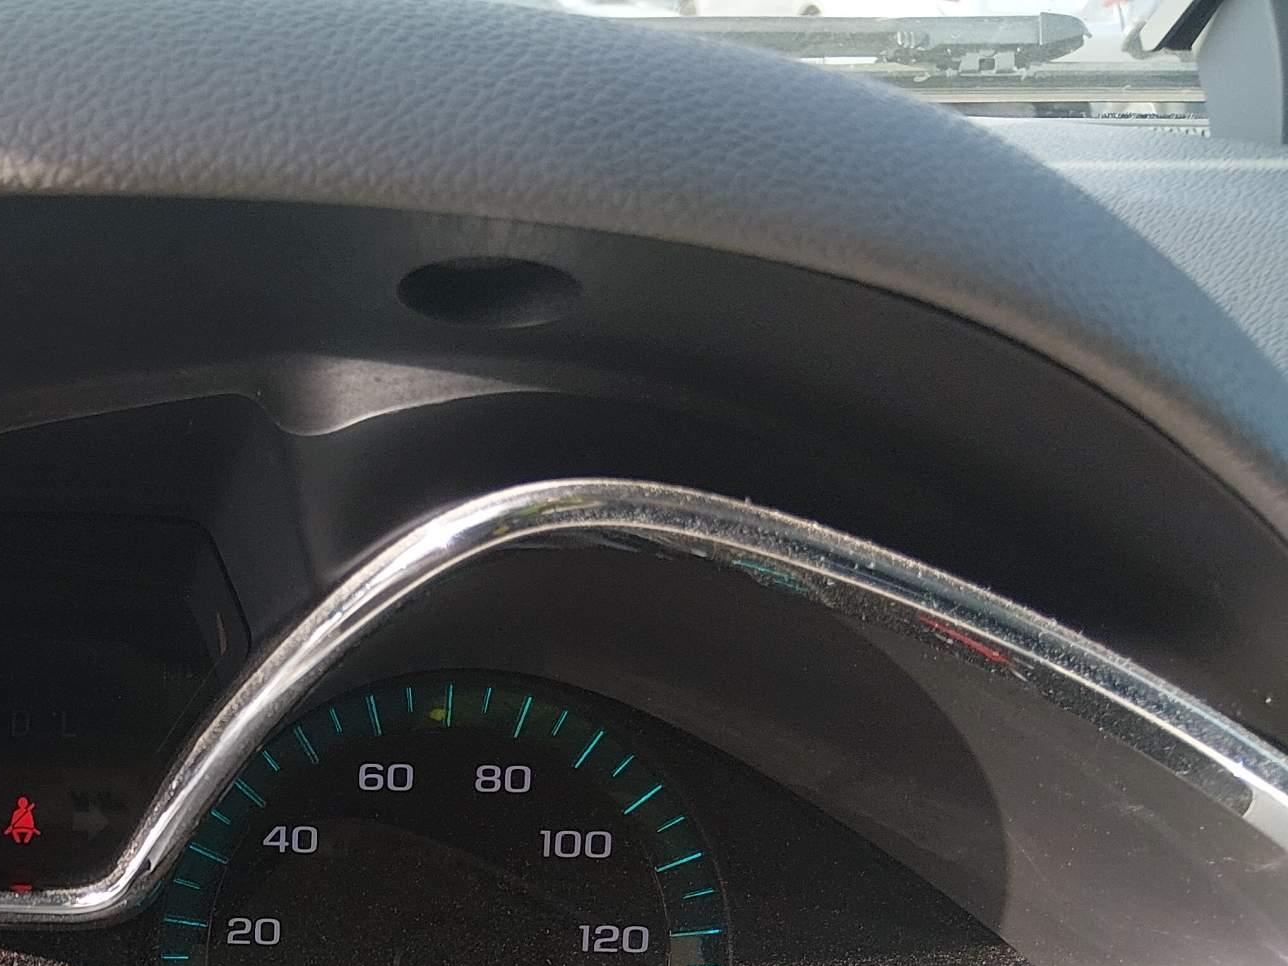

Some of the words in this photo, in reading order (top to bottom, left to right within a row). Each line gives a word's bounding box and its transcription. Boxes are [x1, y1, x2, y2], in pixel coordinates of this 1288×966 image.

[358, 763, 413, 791] 60
[475, 765, 532, 793] 80
[262, 825, 318, 854] 40
[540, 829, 612, 859] 100
[226, 917, 281, 946] 20
[579, 924, 649, 953] 120
